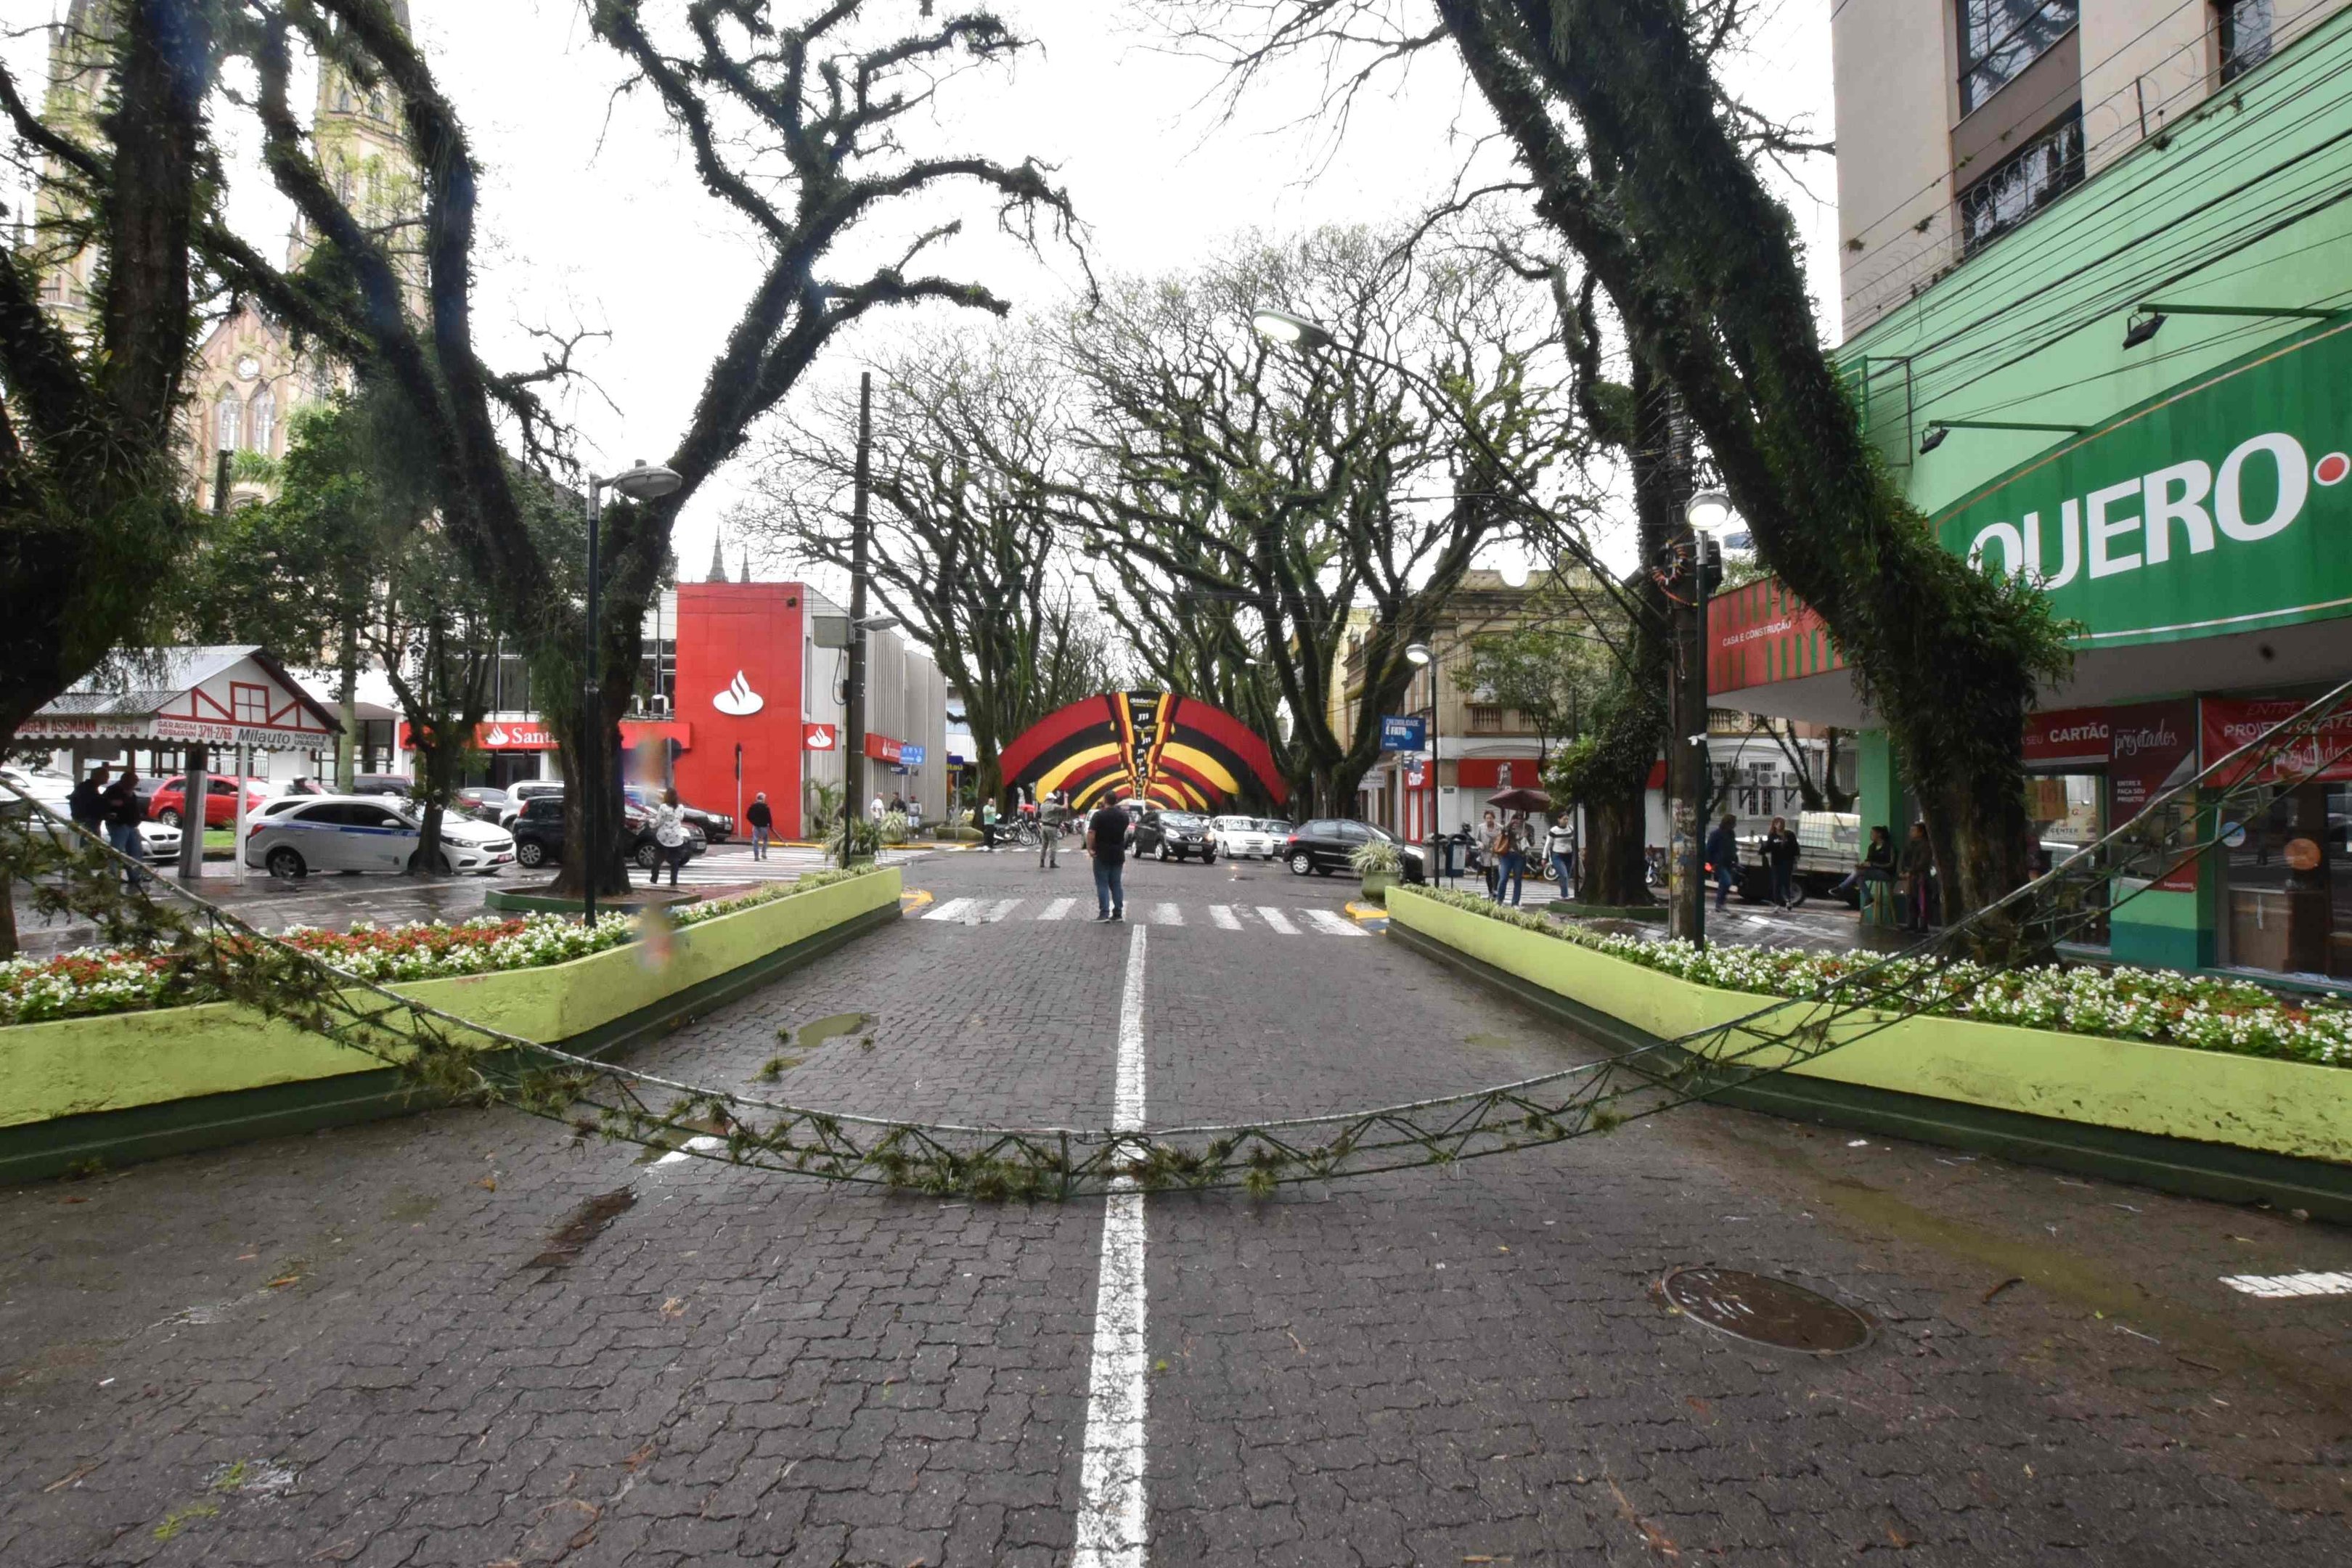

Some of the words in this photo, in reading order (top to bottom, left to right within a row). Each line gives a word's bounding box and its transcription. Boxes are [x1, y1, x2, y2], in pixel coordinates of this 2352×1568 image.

[1967, 433, 2308, 590] QUERO
[1723, 634, 1739, 646] CASA
[1740, 633, 1744, 642] E
[1745, 619, 1792, 640] CONSTRUÇÃO
[52, 719, 97, 732] ASSMANN
[158, 721, 197, 730] GARAGEM
[2049, 722, 2108, 743] CARTÃO
[237, 728, 290, 744] Milauto
[512, 727, 560, 744] Sant
[2115, 719, 2177, 759] projetados
